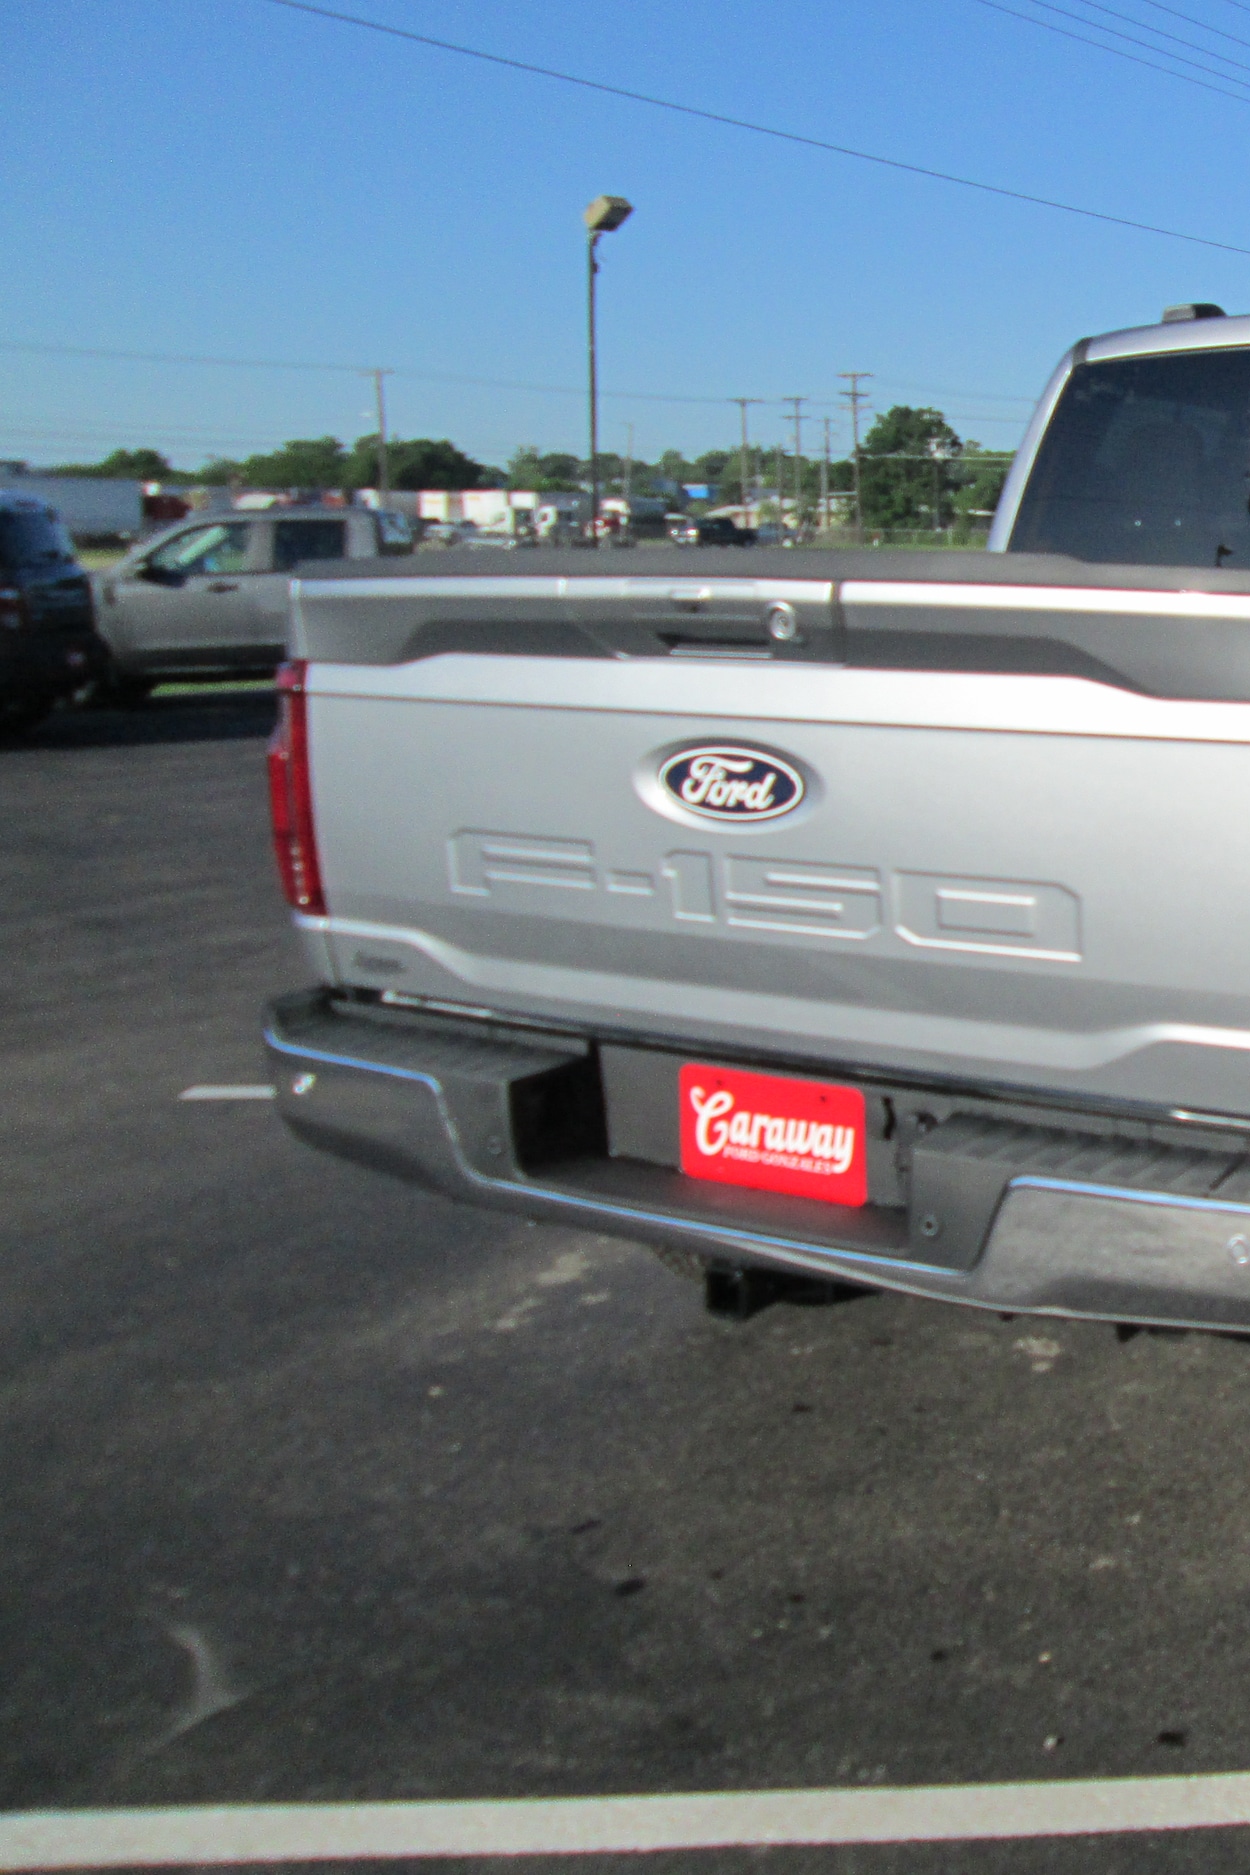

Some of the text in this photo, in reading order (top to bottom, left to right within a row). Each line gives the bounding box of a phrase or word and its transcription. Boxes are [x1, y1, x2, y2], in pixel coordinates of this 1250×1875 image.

[682, 756, 776, 809] Ford
[449, 828, 1082, 962] F-150
[690, 1086, 855, 1175] Caraway
